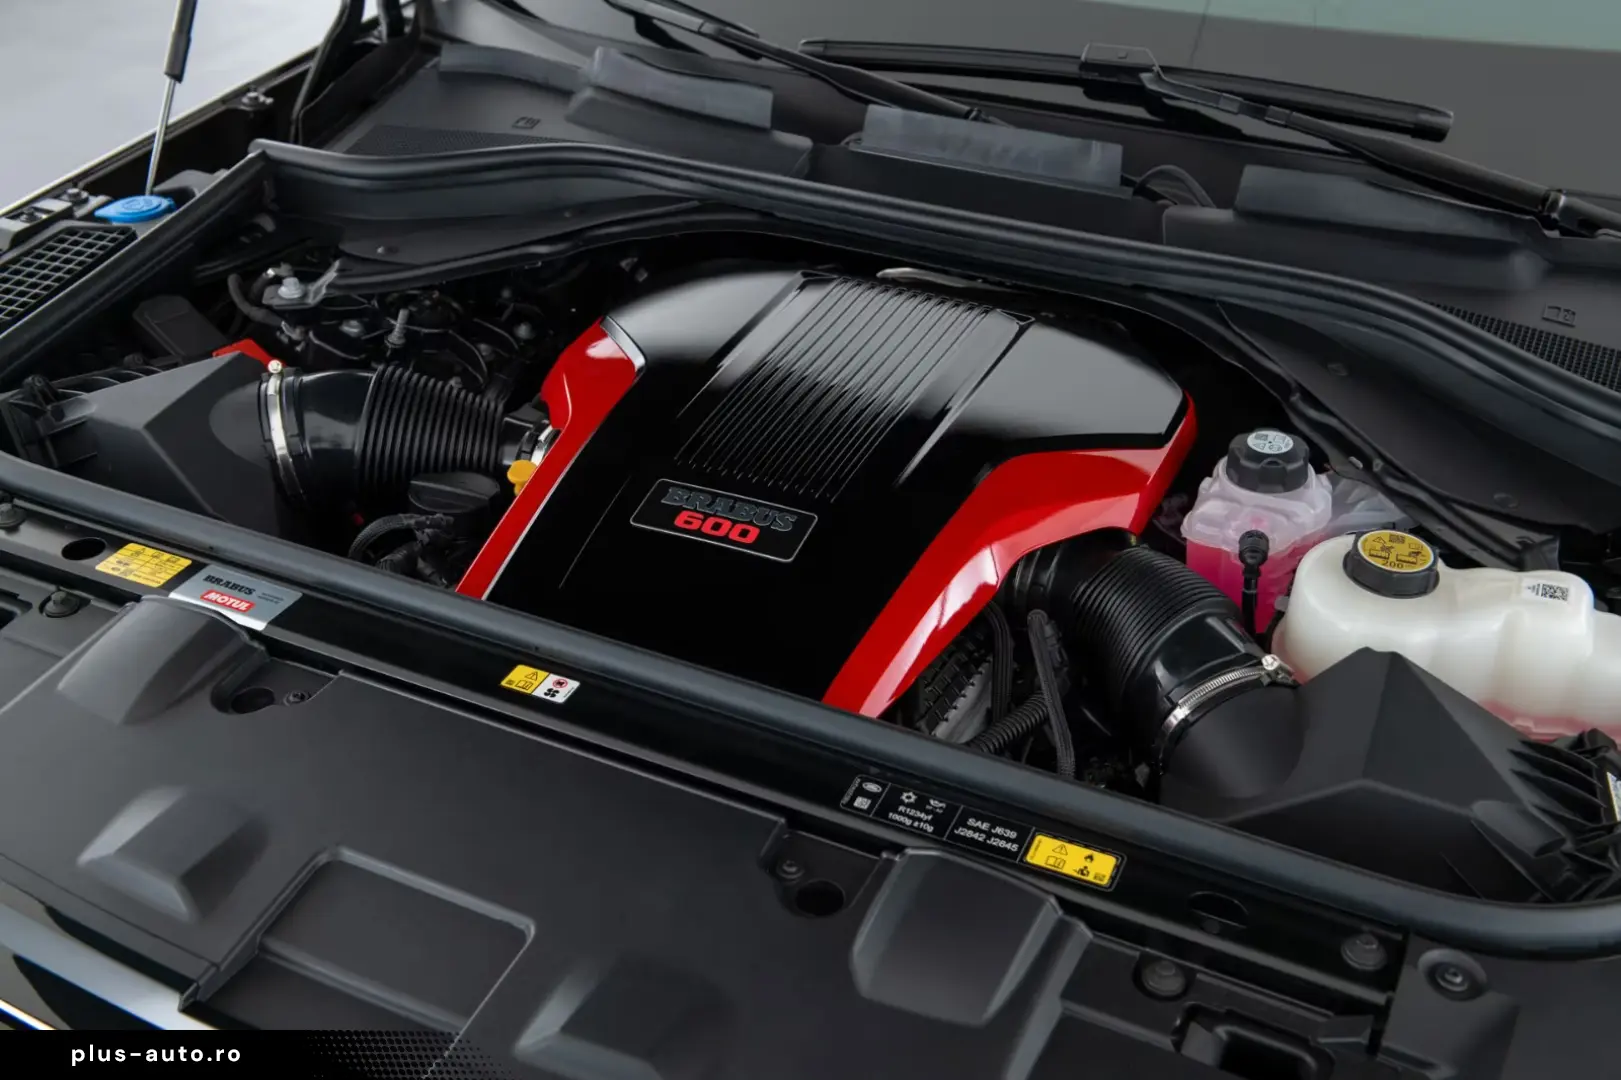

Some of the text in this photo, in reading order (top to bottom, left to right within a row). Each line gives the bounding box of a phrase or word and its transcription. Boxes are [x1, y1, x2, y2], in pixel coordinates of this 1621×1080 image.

[660, 486, 798, 532] BRABUS
[674, 510, 760, 544] 600
[203, 574, 256, 596] BRABUS
[203, 591, 252, 611] MOTUL
[898, 805, 933, 821] R1234yf
[966, 817, 1018, 839] SAE J639
